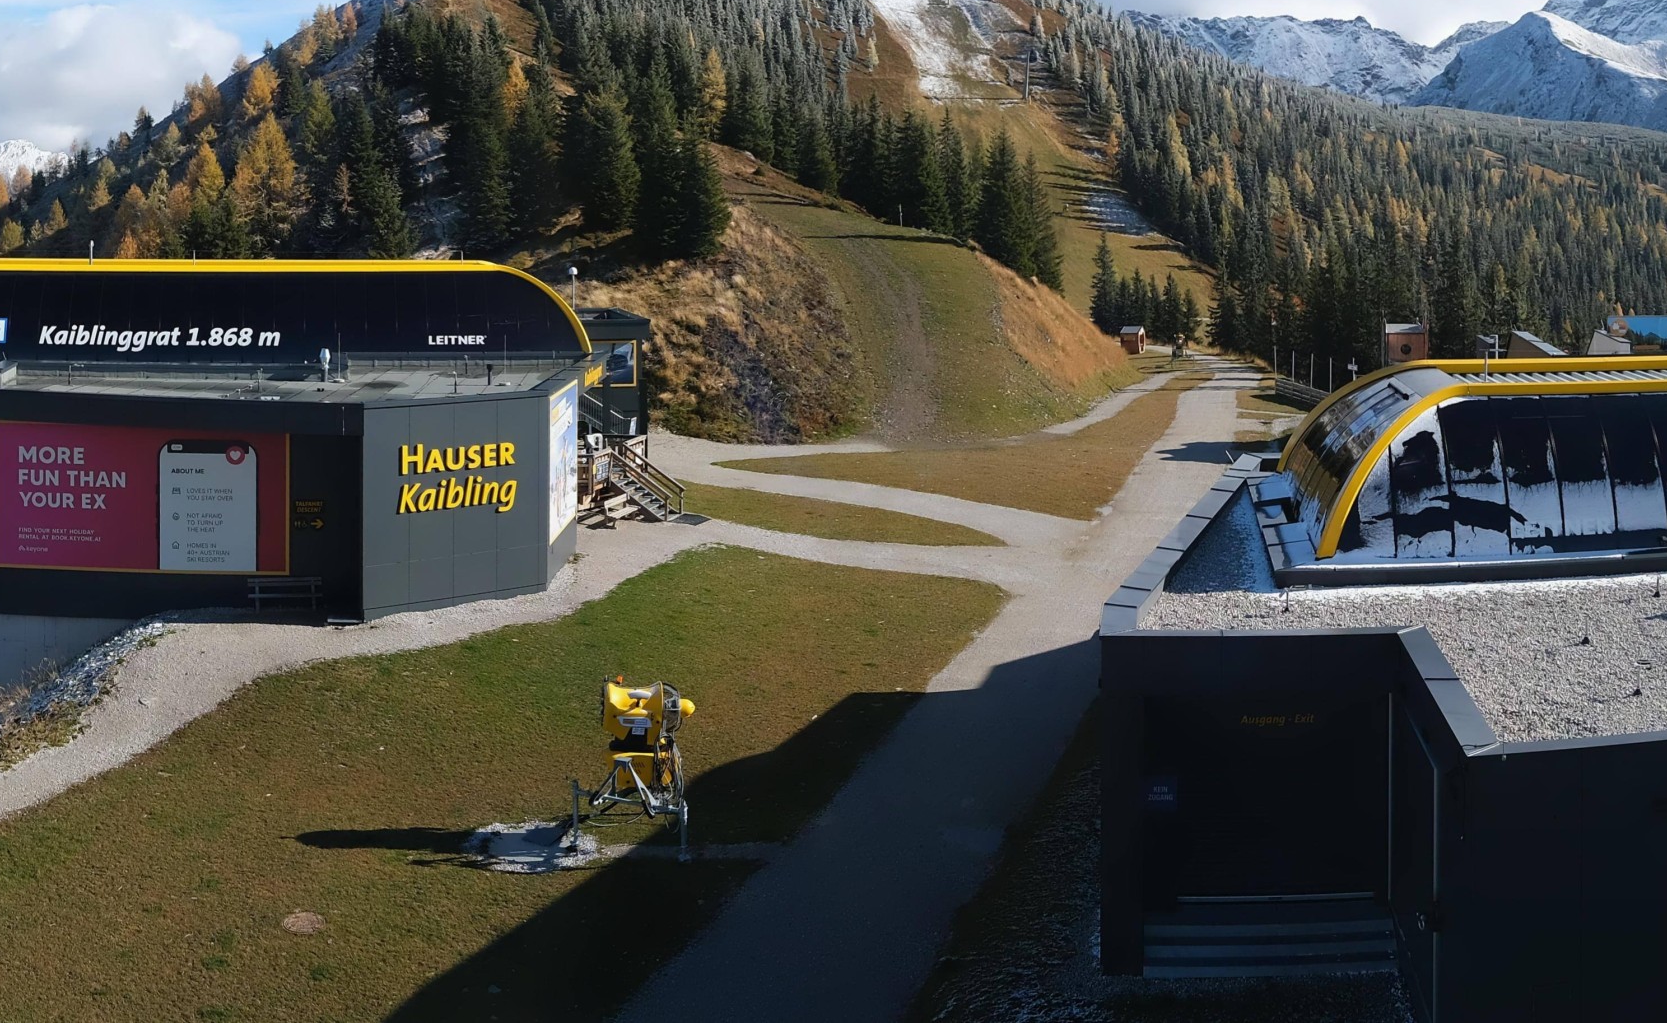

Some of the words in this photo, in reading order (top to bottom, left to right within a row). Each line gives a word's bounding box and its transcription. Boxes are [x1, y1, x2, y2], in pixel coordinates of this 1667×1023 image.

[38, 324, 181, 352] Kaiblinggrat
[185, 327, 254, 347] 1.868
[258, 331, 281, 347] m
[428, 335, 486, 346] LEITNER
[18, 446, 85, 465] MORE
[400, 442, 516, 475] HAUSER
[18, 468, 59, 486] FUN
[66, 470, 126, 488] THAN
[19, 491, 75, 509] YOUR
[81, 493, 107, 510] EX
[398, 475, 518, 514] Kaibling
[1240, 715, 1285, 727] Ausgang
[1294, 713, 1315, 723] Exit
